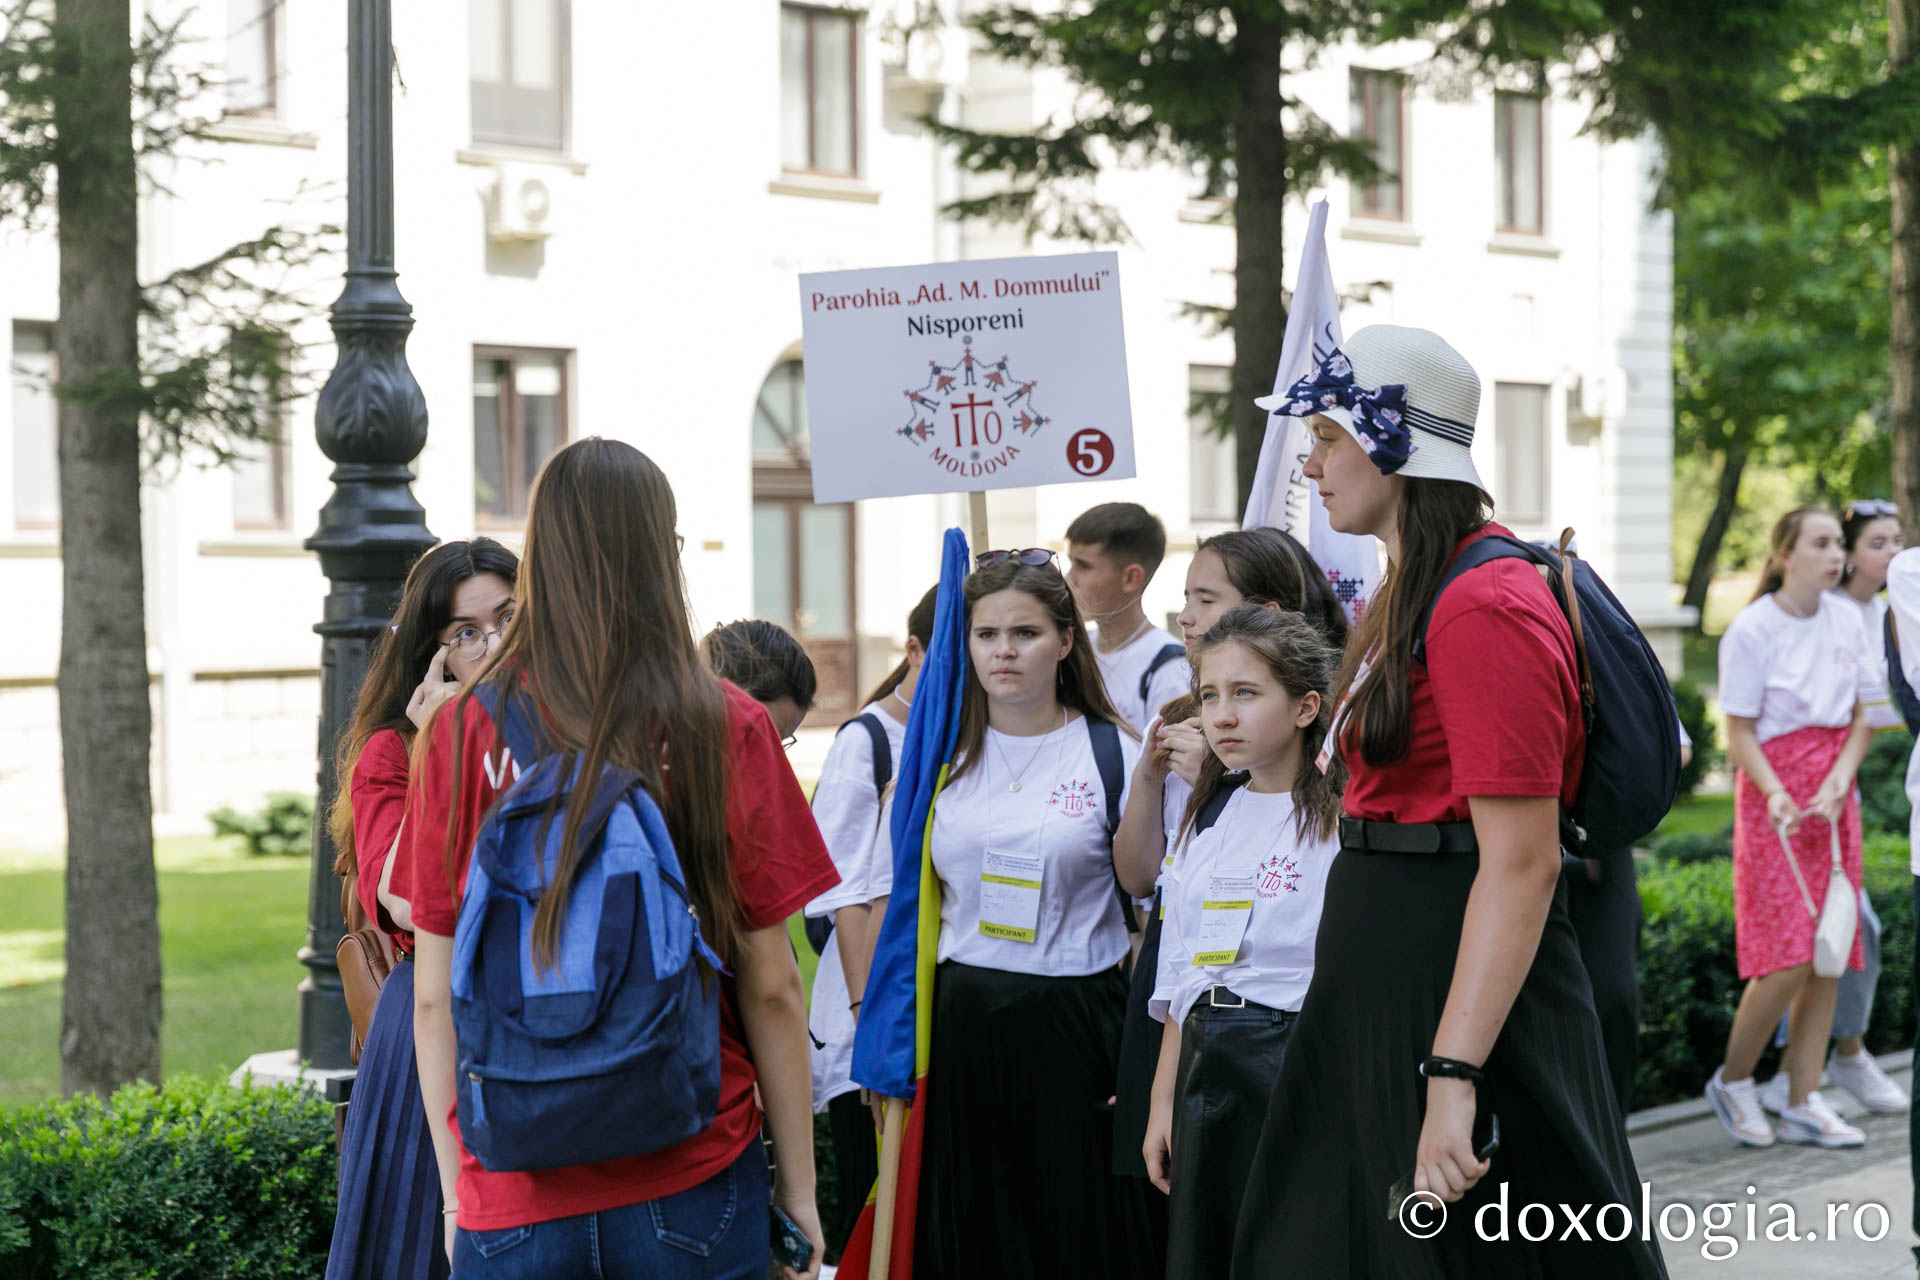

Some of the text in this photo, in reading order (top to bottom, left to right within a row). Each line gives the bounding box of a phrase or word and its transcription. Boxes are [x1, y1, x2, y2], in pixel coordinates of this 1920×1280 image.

[811, 287, 901, 312] Parohia
[960, 280, 987, 300] M.
[907, 308, 1024, 338] Nisporeni
[950, 393, 1002, 447] ITO
[929, 445, 1021, 478] MOLDOVA
[1075, 433, 1104, 475] 5
[984, 925, 1027, 939] PARTICIPANT
[1198, 954, 1231, 962] PARTICIPANT
